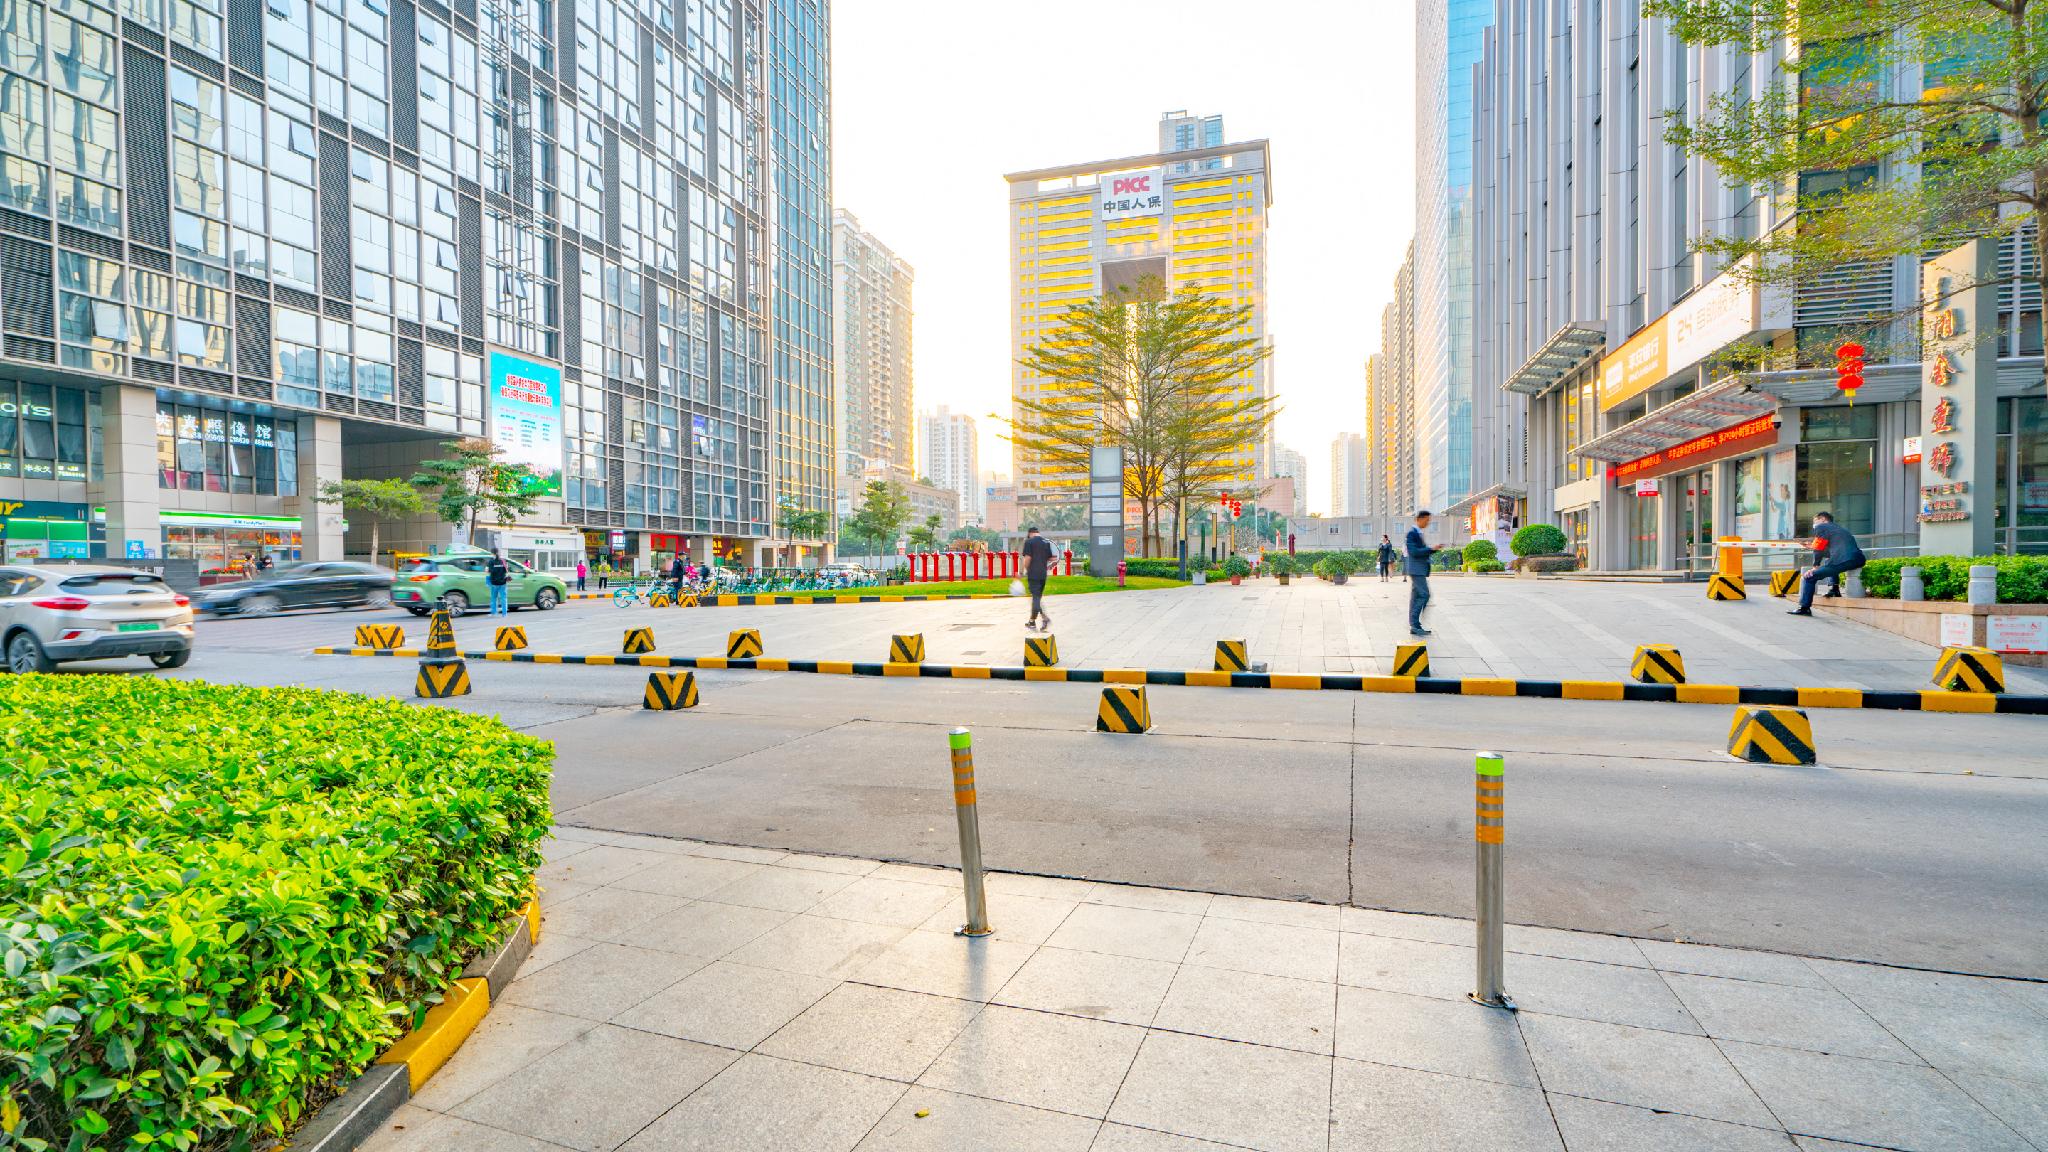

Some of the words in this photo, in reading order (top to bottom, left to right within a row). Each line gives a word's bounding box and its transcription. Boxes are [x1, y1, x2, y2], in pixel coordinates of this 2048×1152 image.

[1113, 175, 1151, 196] PICC
[1103, 195, 1162, 214] 中国人保
[0, 502, 24, 516] Y
